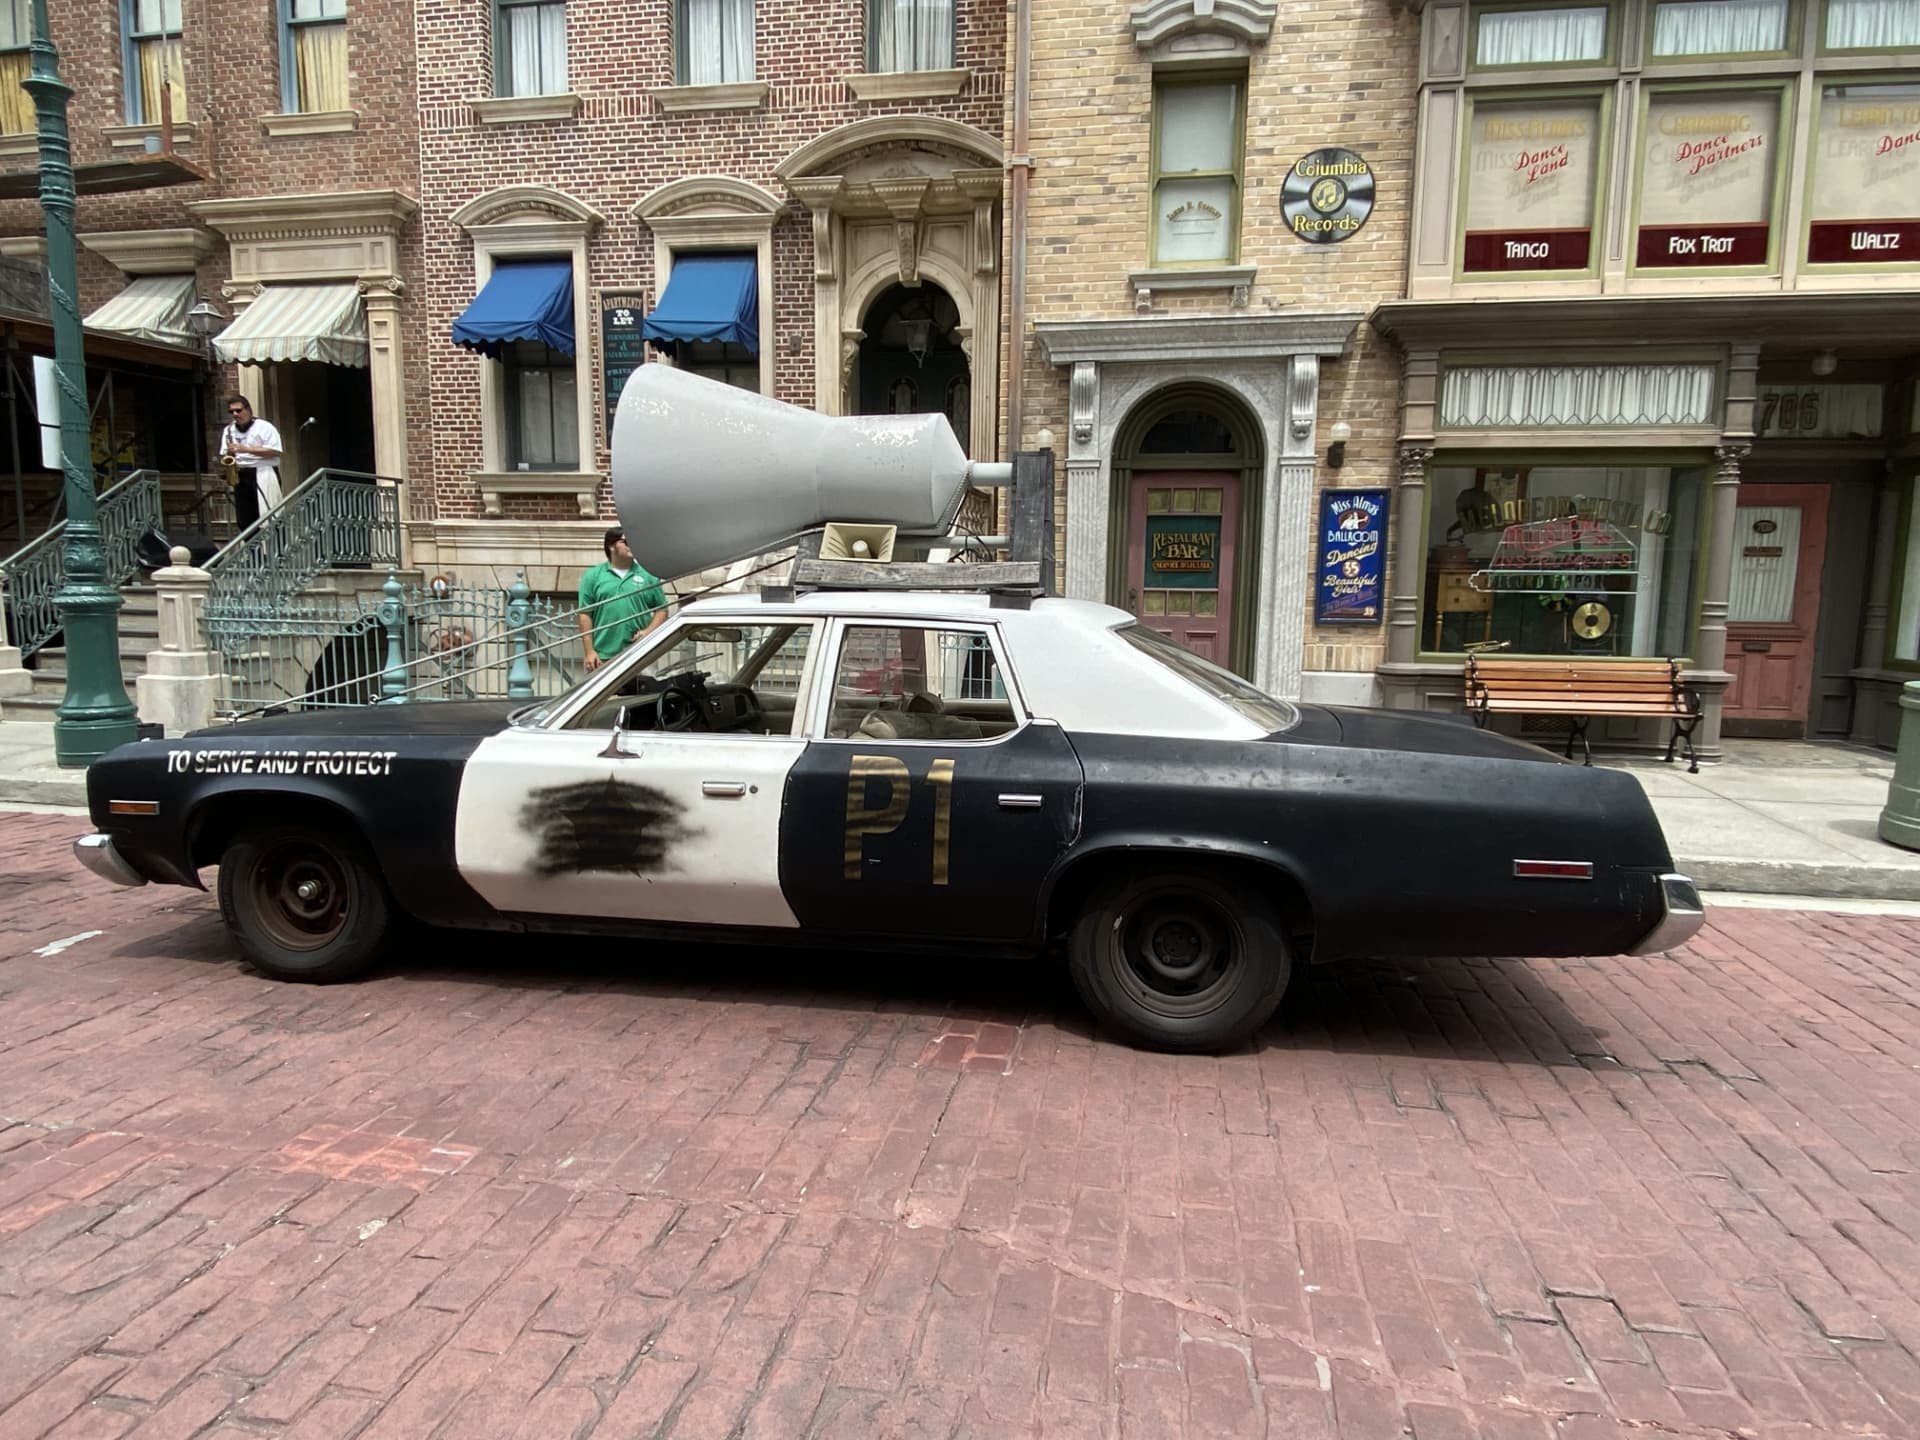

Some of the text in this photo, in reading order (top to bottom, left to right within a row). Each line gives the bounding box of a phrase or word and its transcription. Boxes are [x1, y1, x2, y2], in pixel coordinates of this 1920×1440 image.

[1514, 143, 1566, 172] Dance
[1676, 135, 1729, 162] Dance
[1689, 135, 1762, 176] Partners
[1295, 157, 1368, 178] Columbia
[1527, 151, 1569, 184] Land
[1293, 213, 1360, 233] Records
[1504, 241, 1550, 258] TANGO
[1668, 235, 1736, 254] FOX TROT
[1851, 231, 1900, 250] WALTZ
[612, 316, 635, 326] LET
[615, 309, 630, 318] TO
[1761, 392, 1820, 431] 706
[1330, 500, 1352, 516] Miss
[1152, 532, 1216, 559] RESTAURANT
[1327, 530, 1379, 543] BALLROOM
[1167, 543, 1201, 559] BAR
[1326, 542, 1379, 568] Dancing
[1343, 560, 1360, 576] 35
[1323, 574, 1378, 588] Beautiful
[167, 750, 397, 774] TO SERVE AND PROTECT
[844, 755, 956, 885] P1
